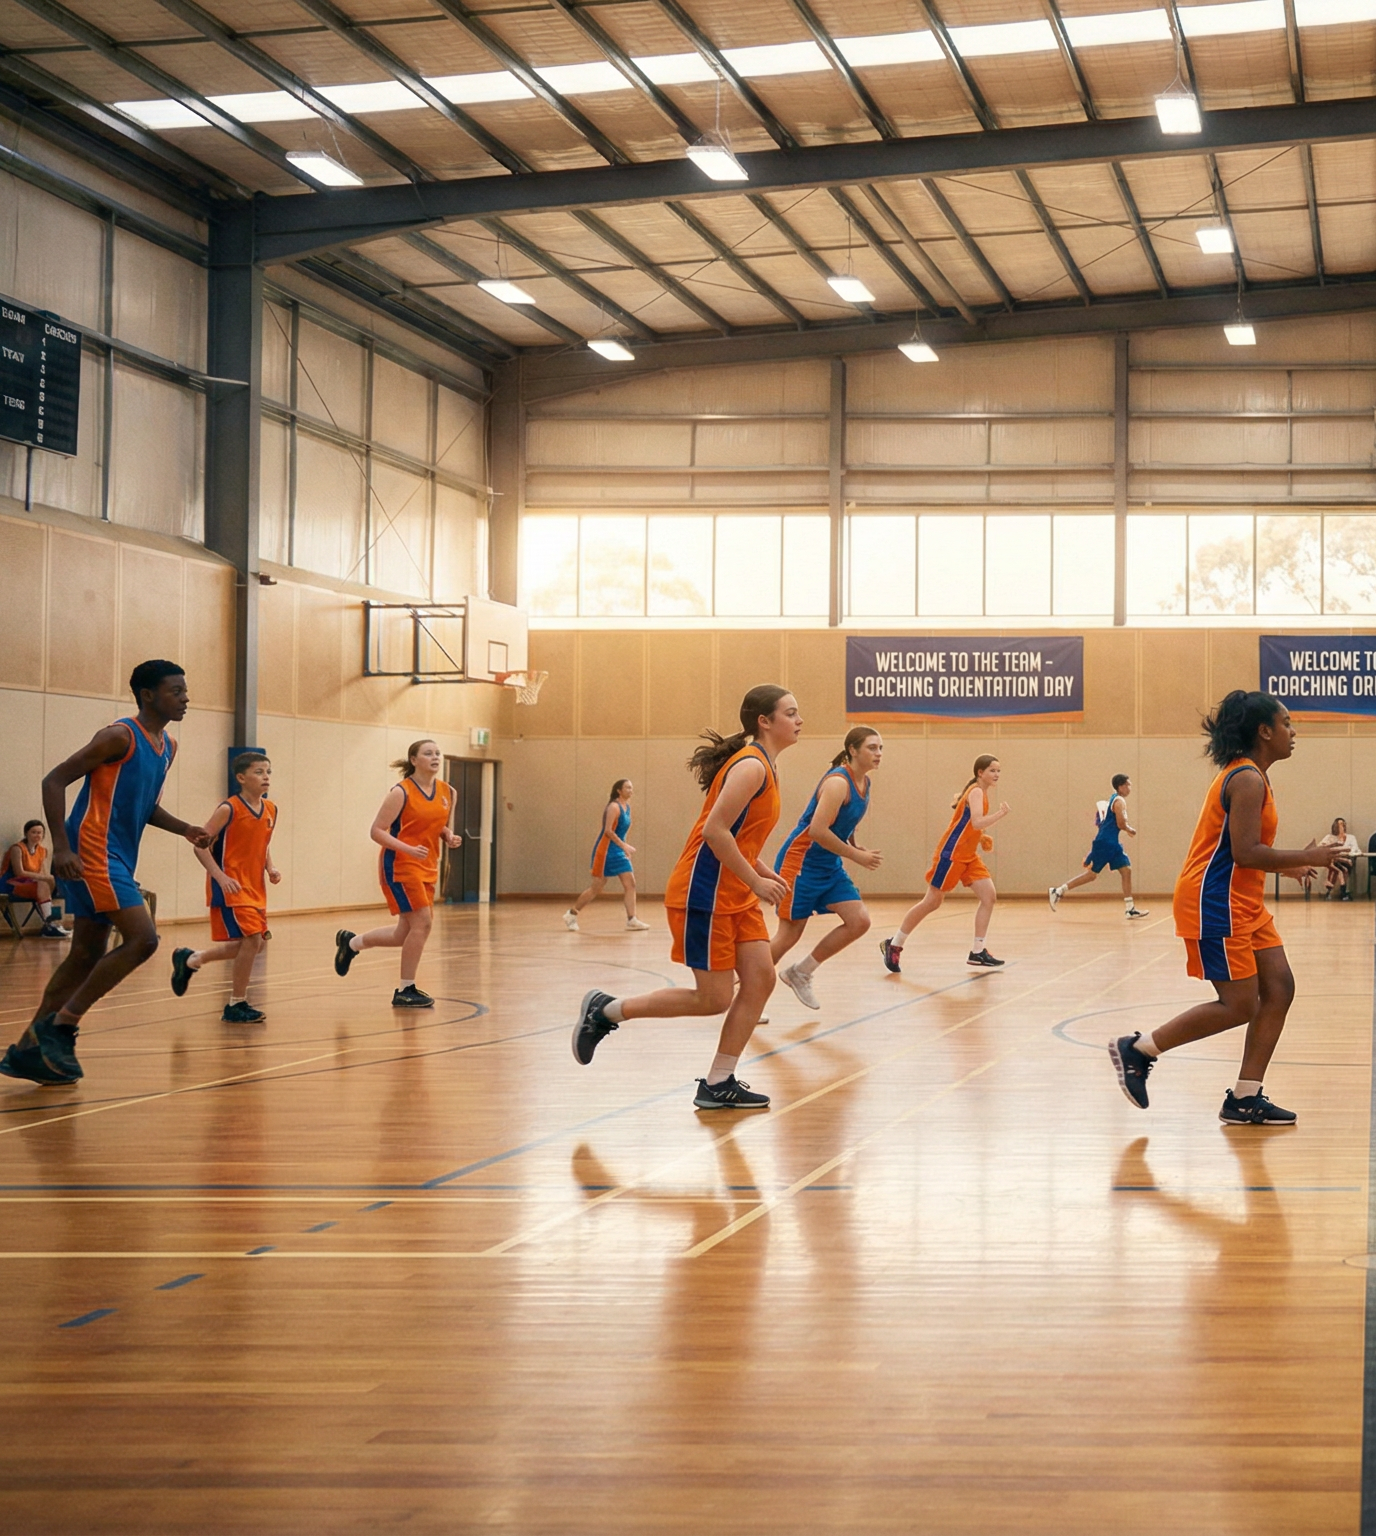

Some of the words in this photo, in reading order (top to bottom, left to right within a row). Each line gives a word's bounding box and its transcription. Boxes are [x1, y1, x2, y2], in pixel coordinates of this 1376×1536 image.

[875, 651, 947, 672] WELCOME
[949, 652, 969, 672] TO
[972, 652, 999, 672] THE
[1002, 652, 1042, 672] TEAM
[1289, 651, 1361, 671] WELCOME
[854, 676, 934, 697] COACHING
[938, 676, 1039, 697] ORIENTATION
[1044, 676, 1074, 697] DAY
[1268, 675, 1348, 696] COACHING
